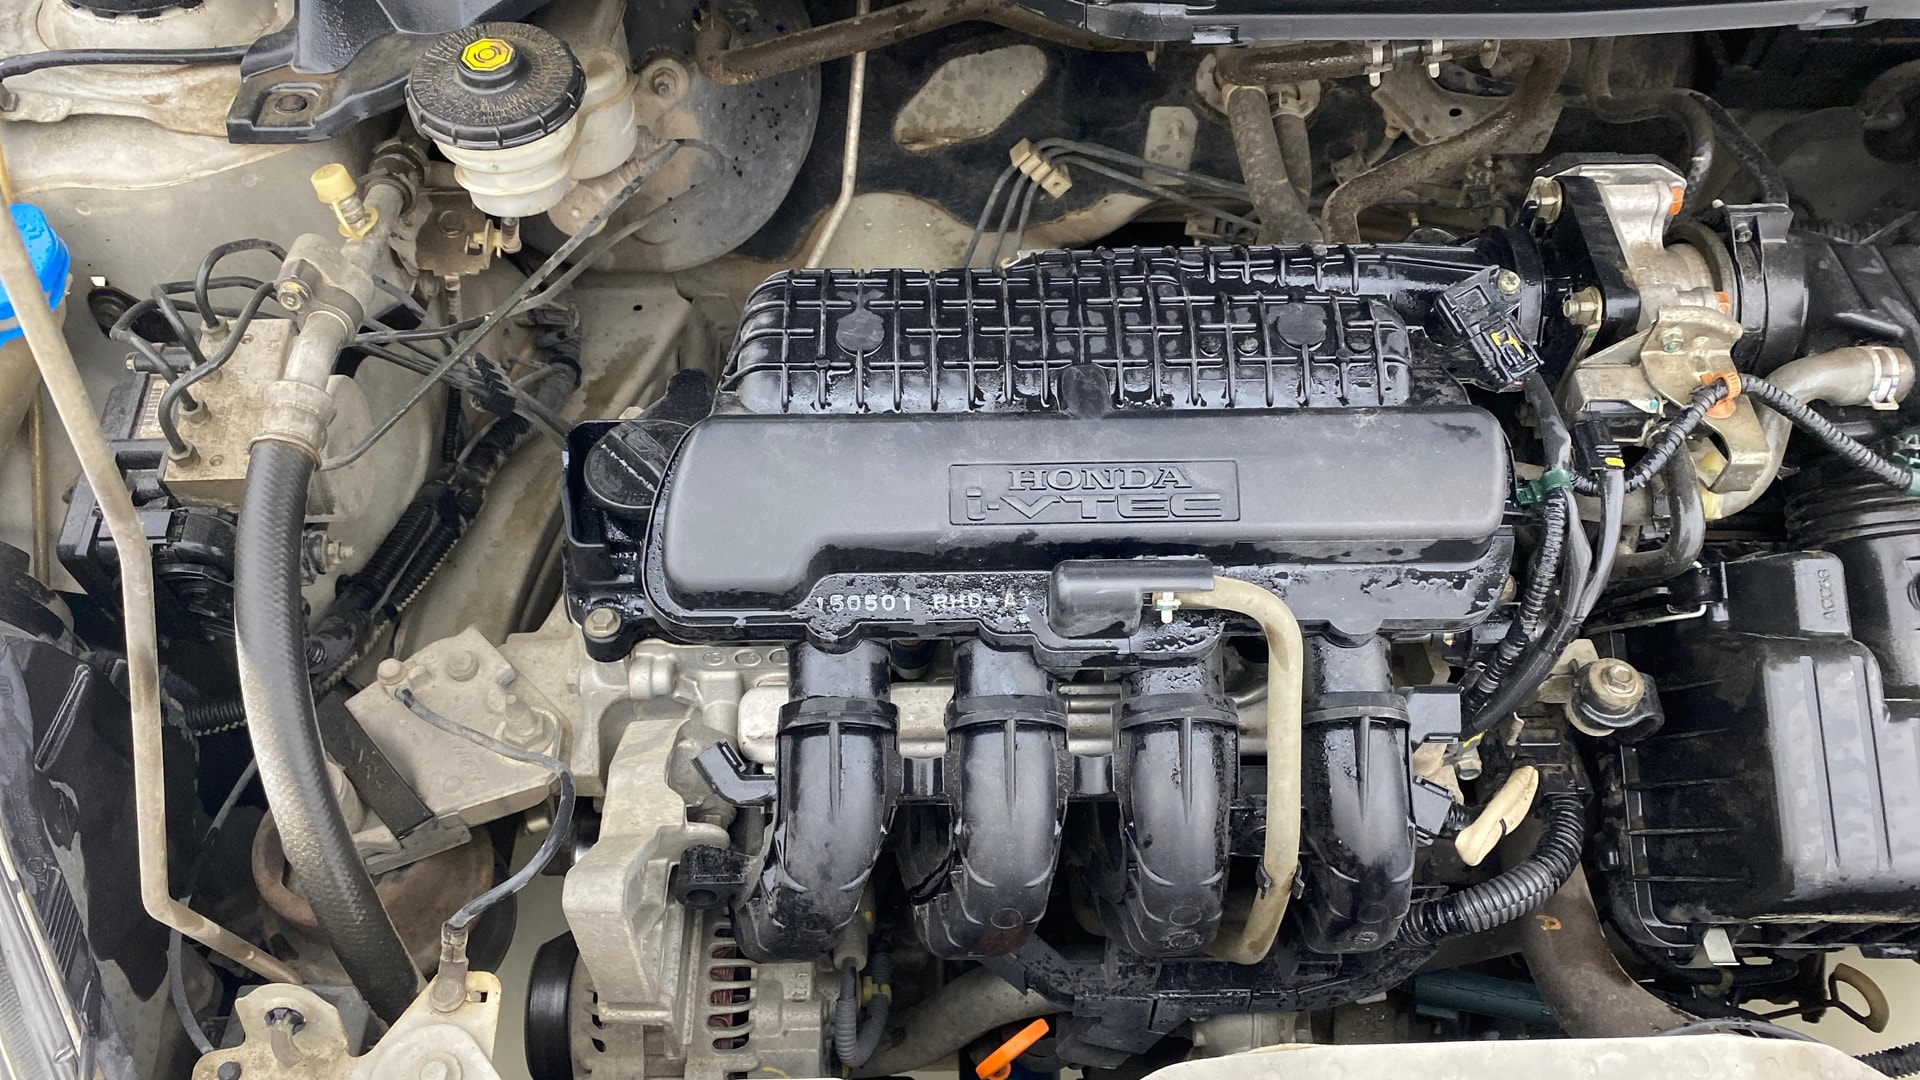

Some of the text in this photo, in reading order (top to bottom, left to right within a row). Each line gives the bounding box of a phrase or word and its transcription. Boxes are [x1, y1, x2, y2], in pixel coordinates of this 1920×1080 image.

[1008, 467, 1193, 491] HONDA
[966, 487, 1223, 521] i-VTEC
[816, 594, 911, 612] 150501
